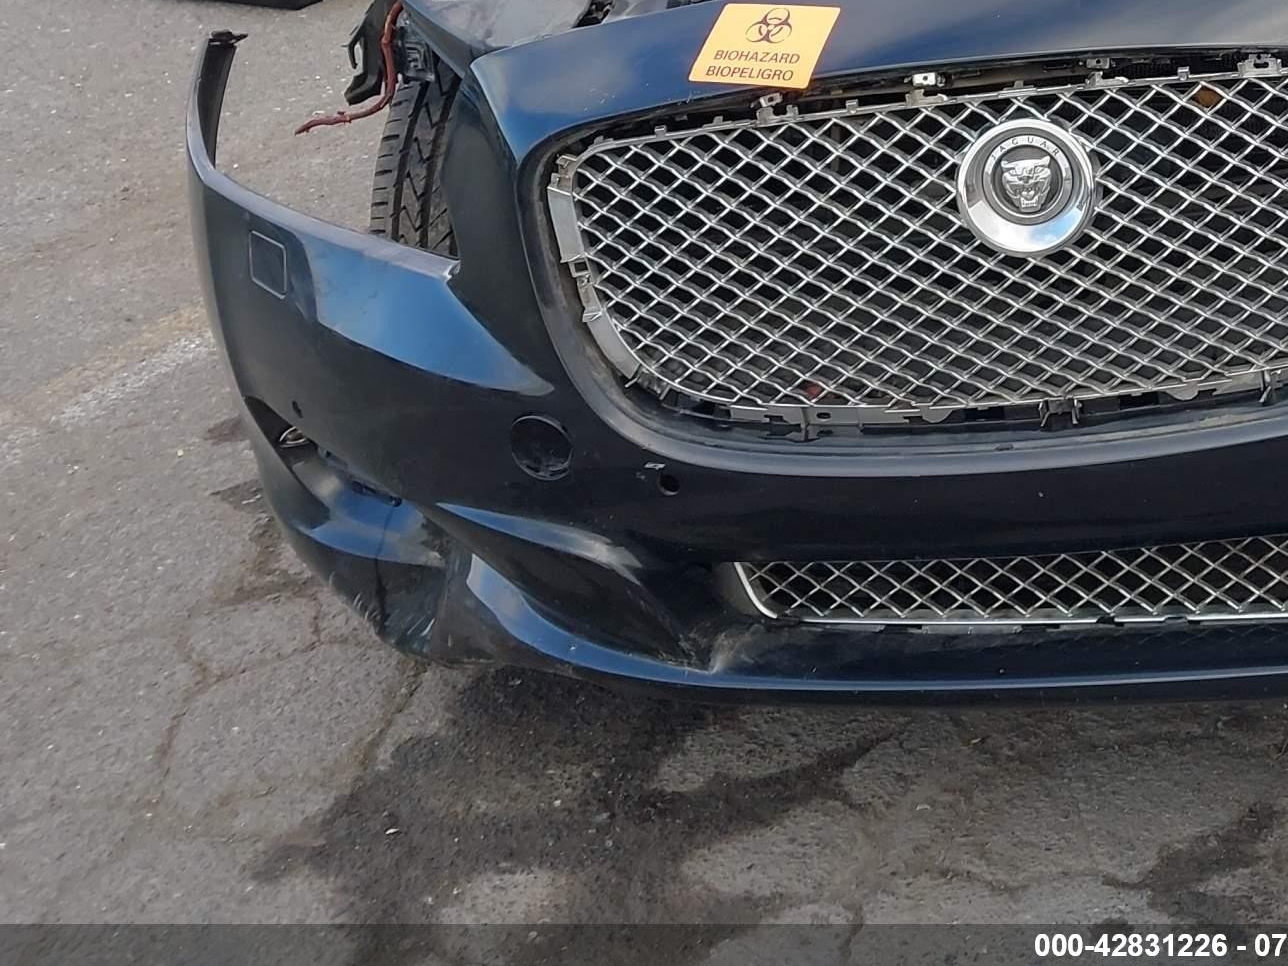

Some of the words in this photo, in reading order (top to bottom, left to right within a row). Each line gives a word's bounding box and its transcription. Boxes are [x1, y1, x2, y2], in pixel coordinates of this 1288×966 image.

[713, 49, 801, 65] BIOHAZARD
[705, 65, 795, 82] BIOPELIGRO
[991, 136, 1060, 161] JAGUAR
